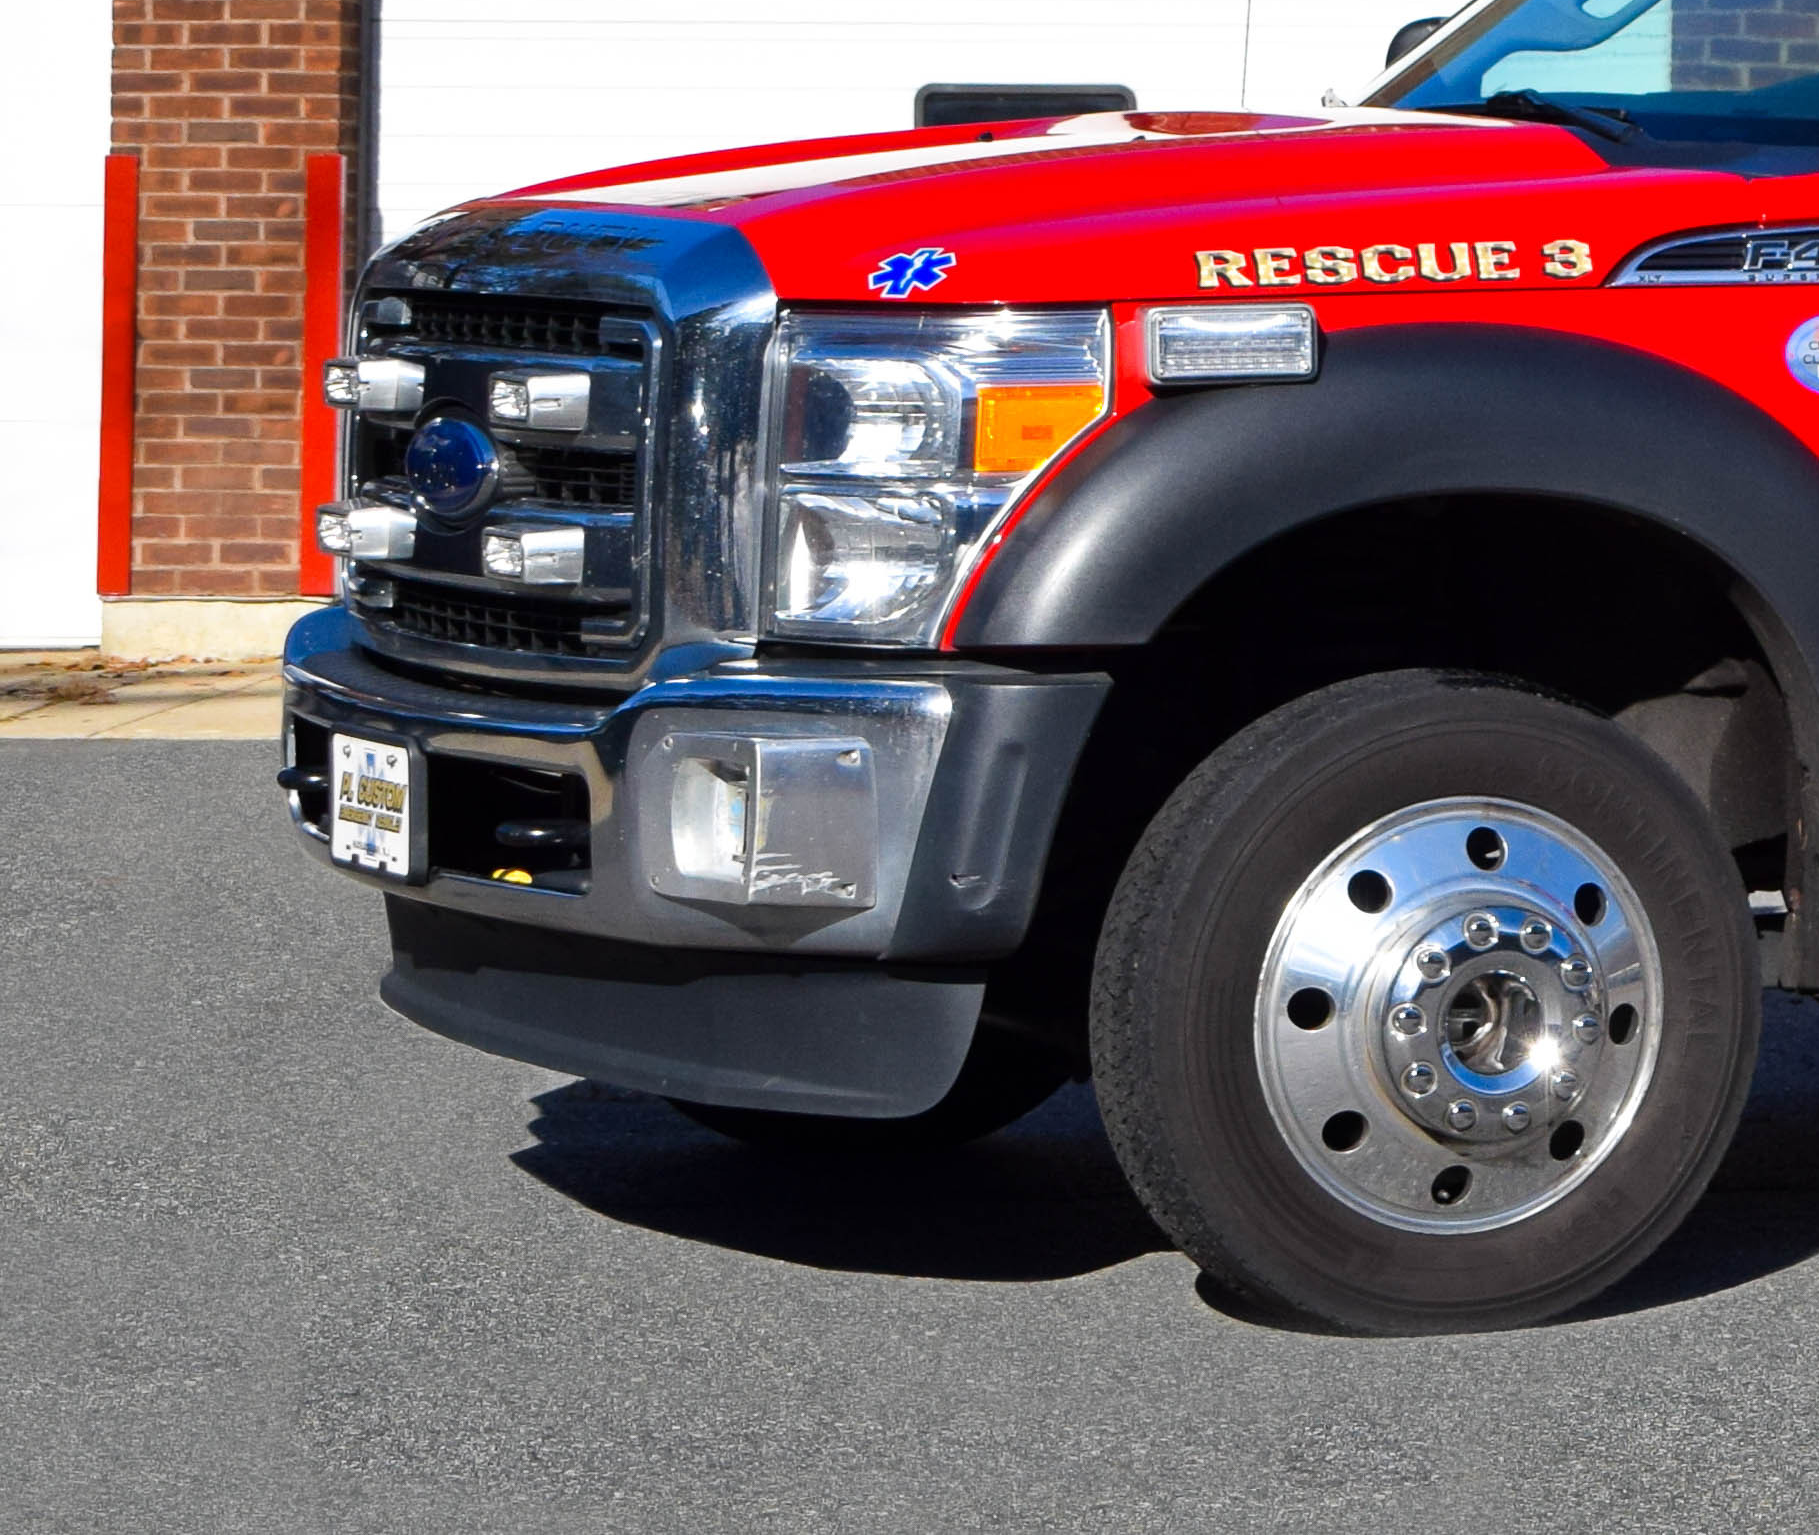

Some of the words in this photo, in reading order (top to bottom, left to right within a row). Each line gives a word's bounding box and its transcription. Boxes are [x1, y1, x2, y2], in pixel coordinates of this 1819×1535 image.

[1195, 240, 1520, 288] RESCUE
[1542, 239, 1593, 278] 3
[357, 774, 408, 814] CUSTOM
